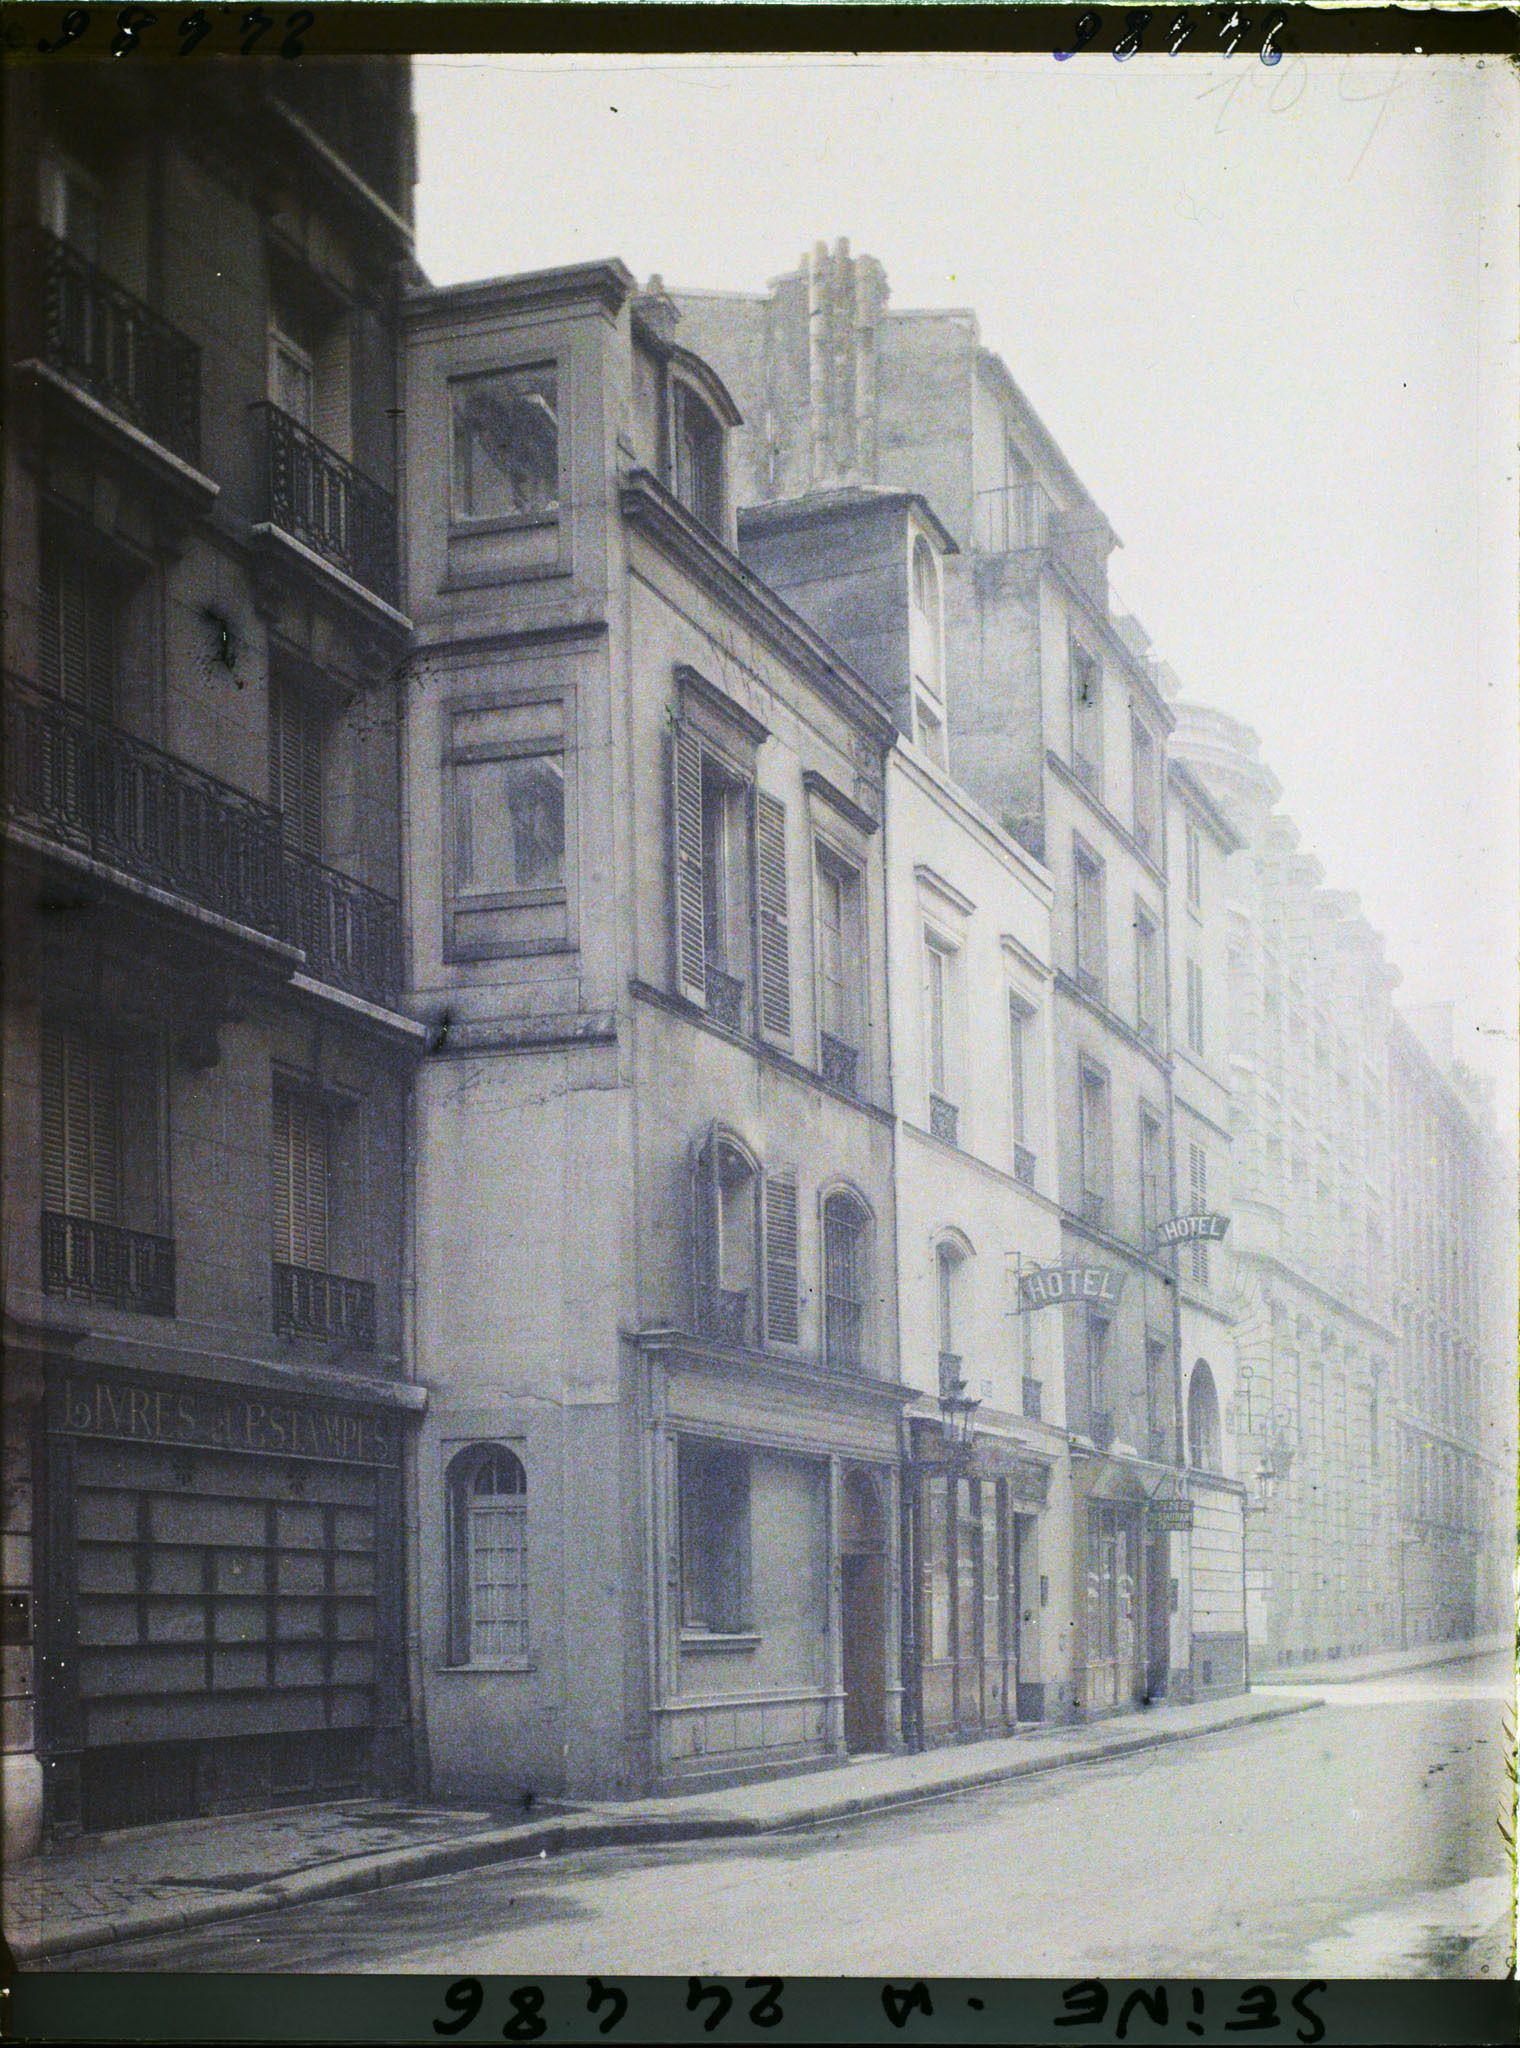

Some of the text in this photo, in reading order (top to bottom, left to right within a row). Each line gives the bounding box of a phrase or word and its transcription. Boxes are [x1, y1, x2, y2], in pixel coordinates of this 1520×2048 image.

[1164, 1216, 1221, 1241] HOTEL
[1026, 1269, 1116, 1302] HOTEL
[62, 1378, 198, 1440] LIVRES
